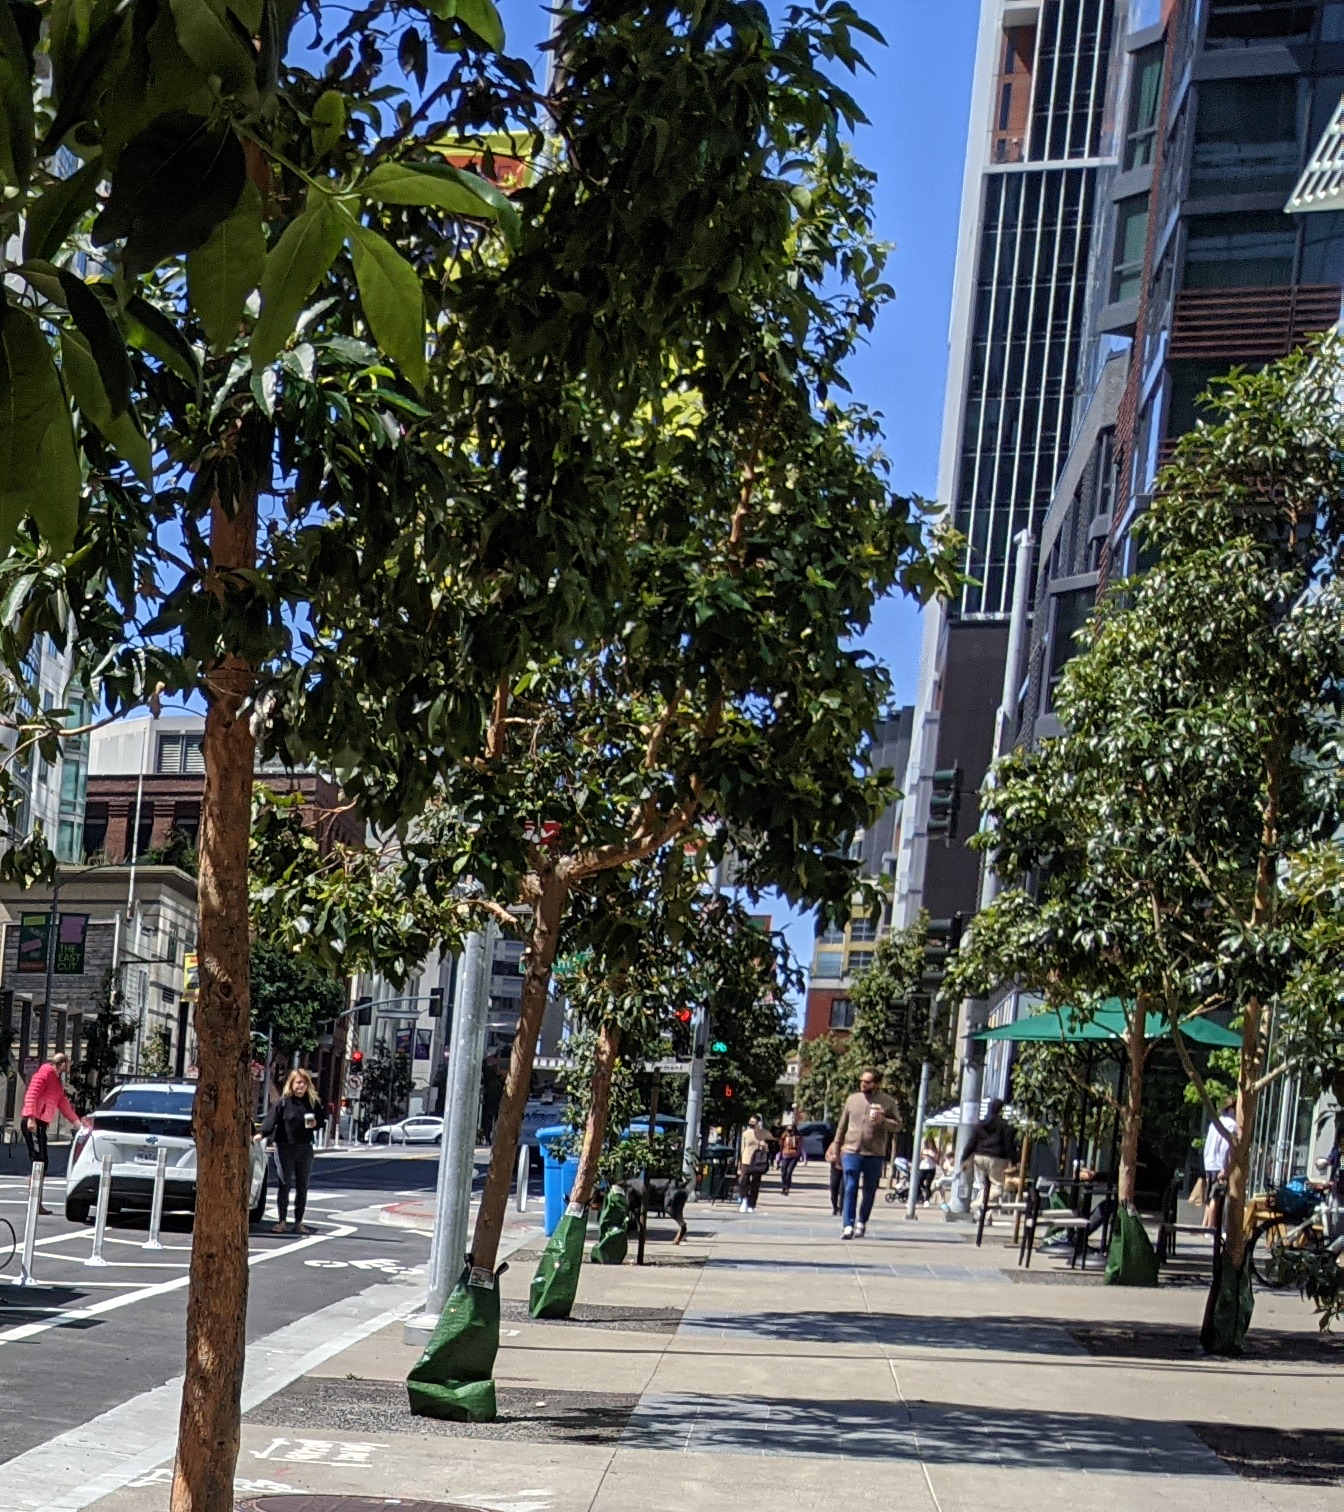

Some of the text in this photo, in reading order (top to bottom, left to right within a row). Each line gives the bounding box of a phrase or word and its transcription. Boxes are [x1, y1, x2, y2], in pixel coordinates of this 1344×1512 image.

[59, 944, 77, 953] THE
[58, 953, 82, 962] EAST
[57, 962, 78, 971] CUT
